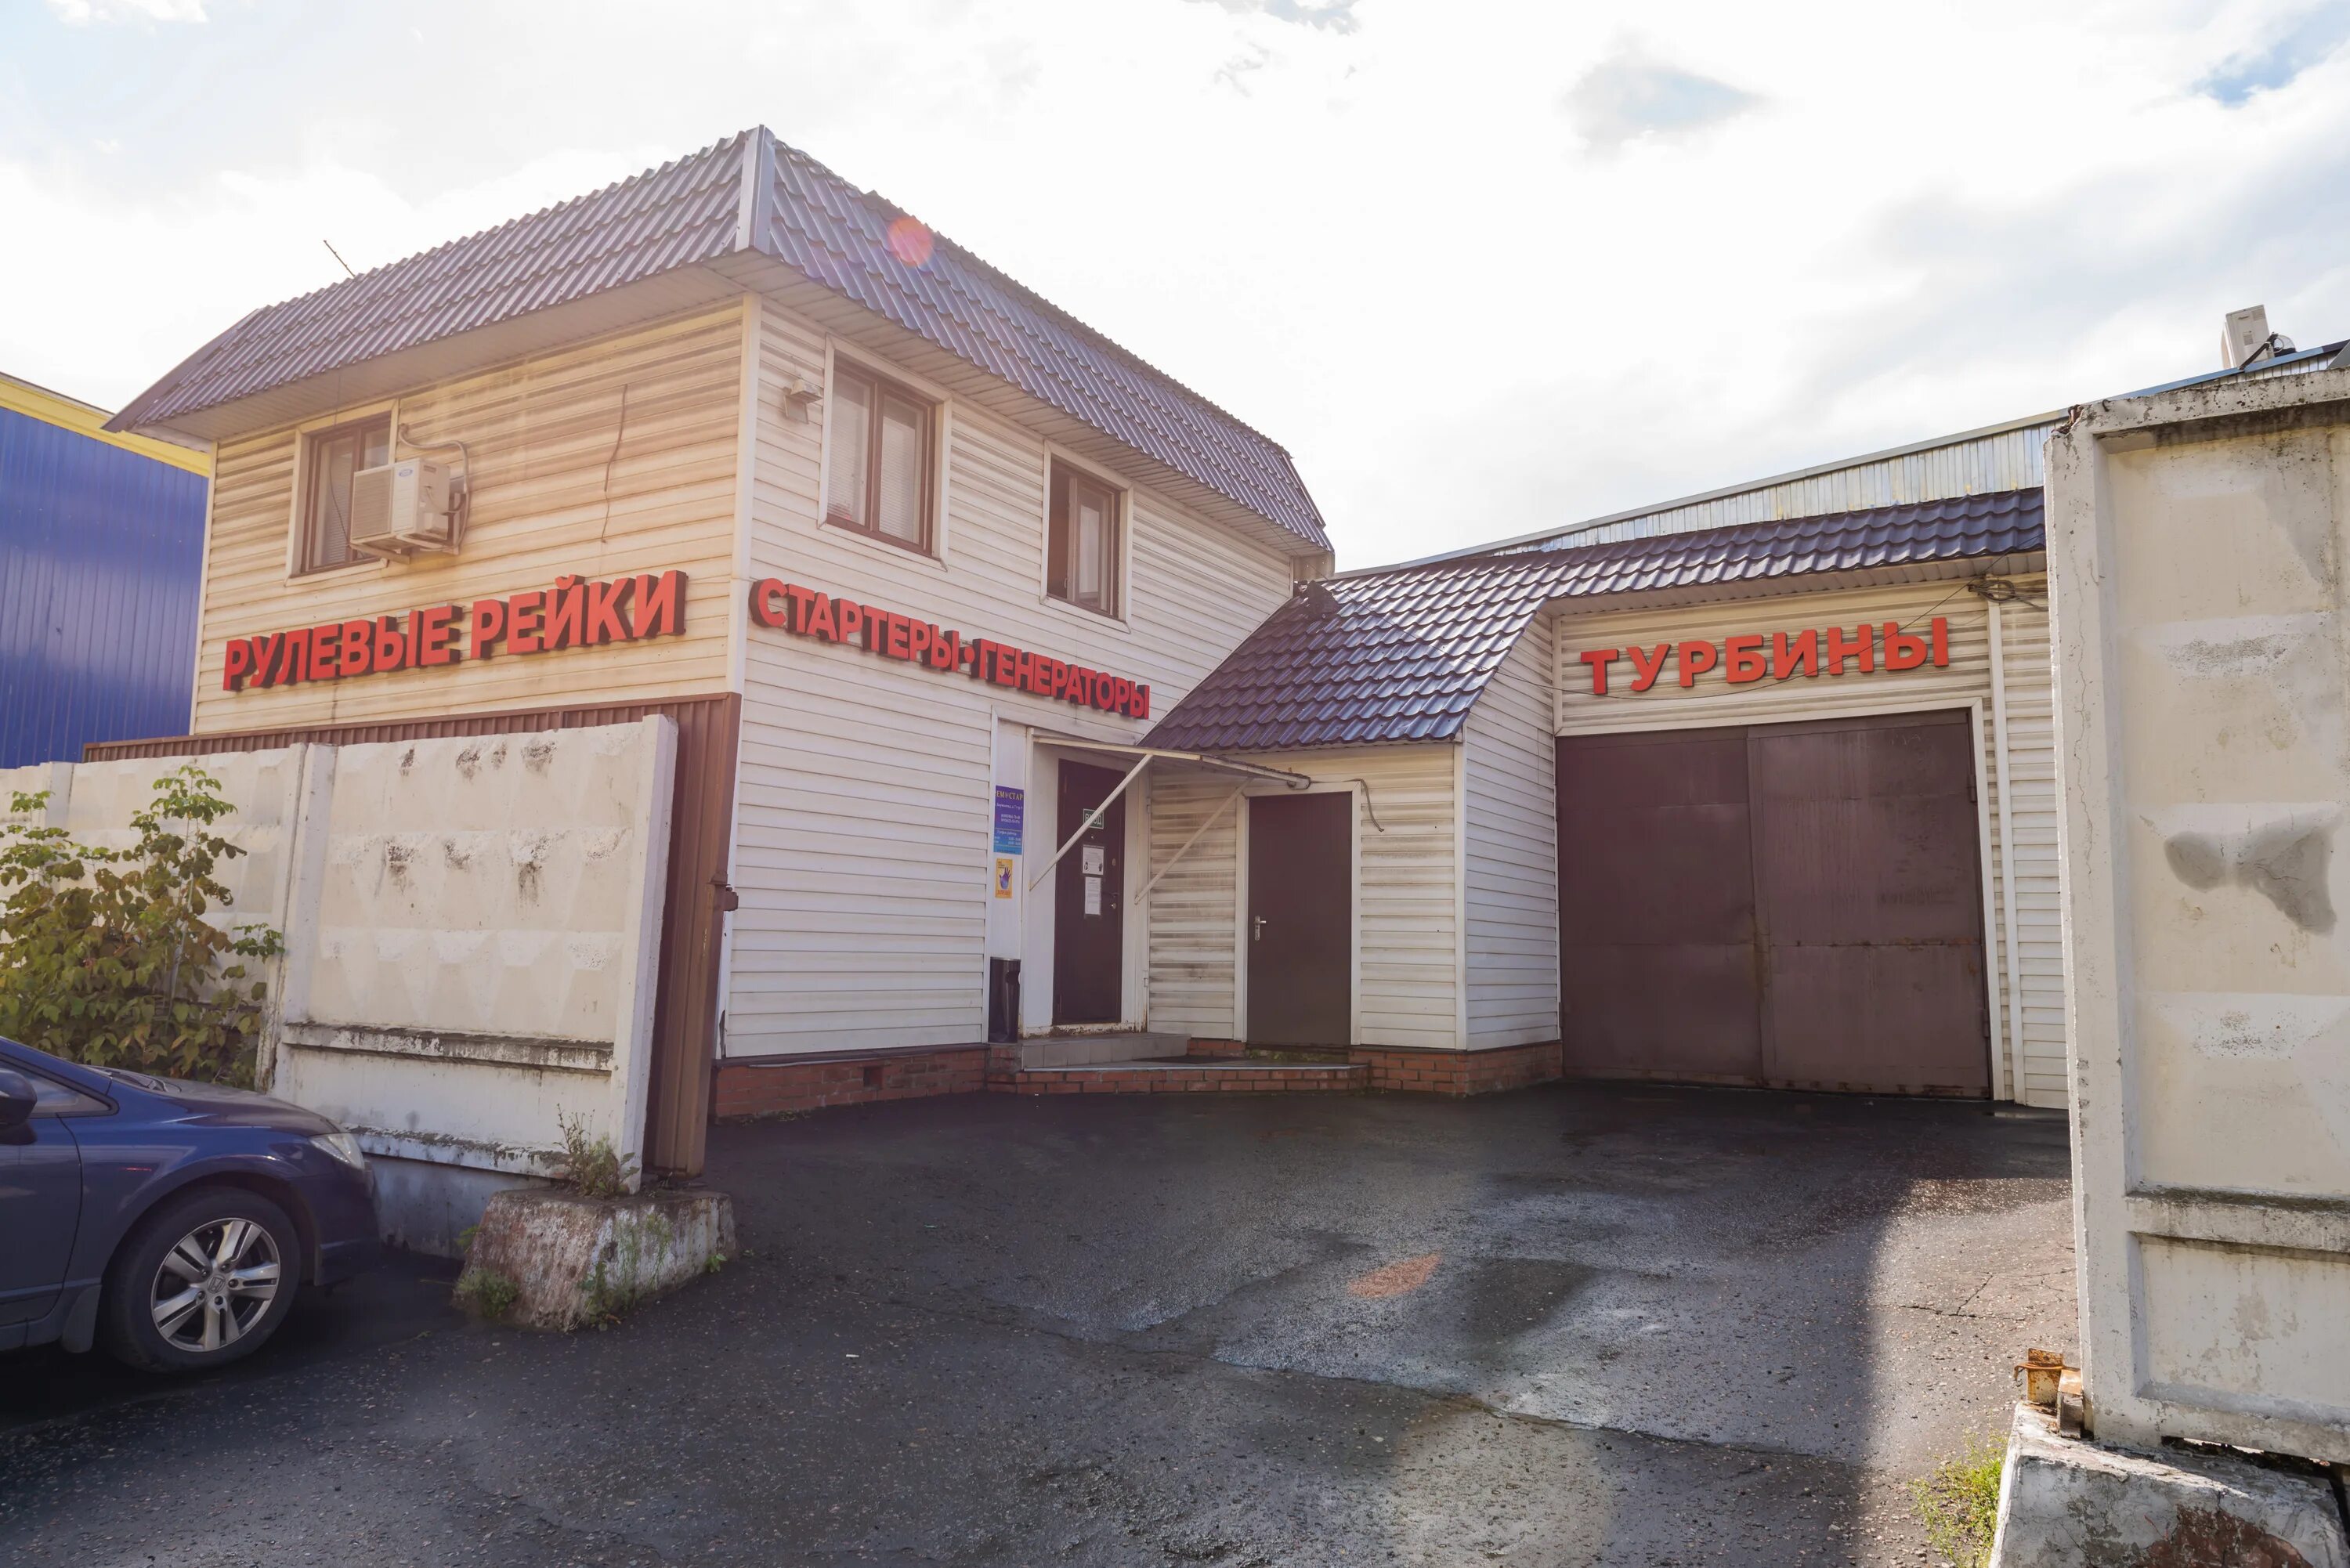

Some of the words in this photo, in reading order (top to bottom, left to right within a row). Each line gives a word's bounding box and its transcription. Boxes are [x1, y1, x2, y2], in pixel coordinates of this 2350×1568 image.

[222, 605, 461, 692] РУЛЕВЫЕ
[470, 570, 685, 660] РЕЙКИ
[750, 578, 959, 672] СТАРТЕРЫ
[971, 638, 1150, 719] ГЕНЕРАТОРЫ
[1580, 617, 1949, 695] ТУРБИНЫ
[1085, 813, 1102, 826] ВОД
